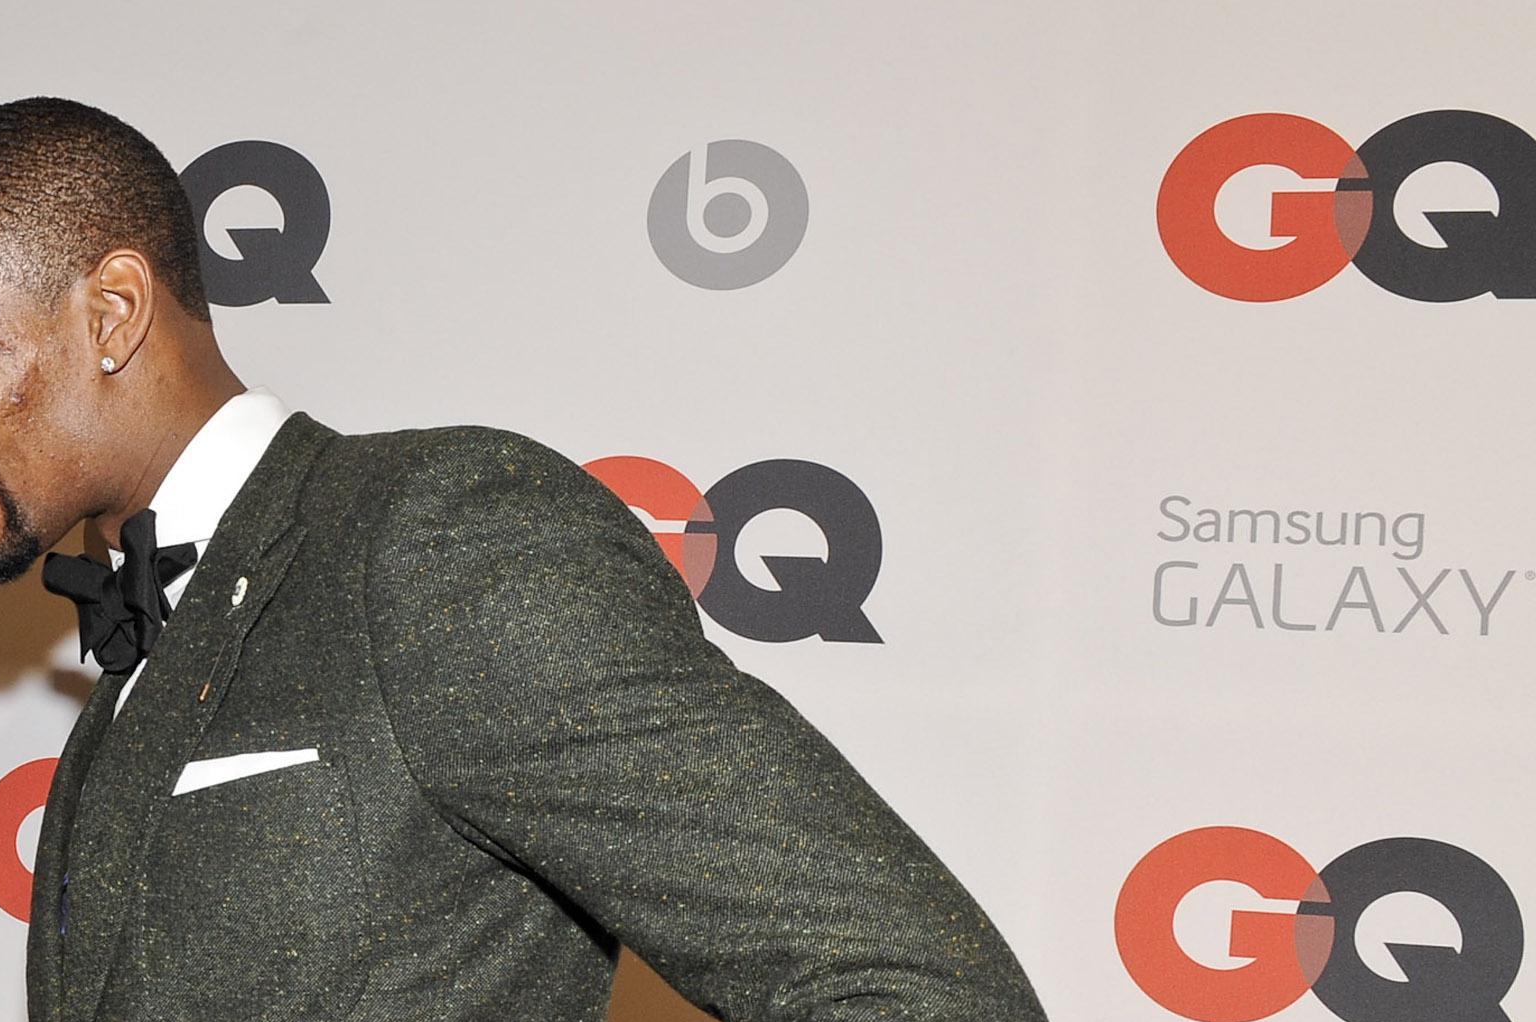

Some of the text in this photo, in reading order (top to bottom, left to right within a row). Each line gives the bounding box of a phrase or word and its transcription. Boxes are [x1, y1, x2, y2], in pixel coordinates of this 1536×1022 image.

[178, 140, 332, 307] Q
[1156, 109, 1536, 303] GQ
[1157, 496, 1425, 560] Samsung
